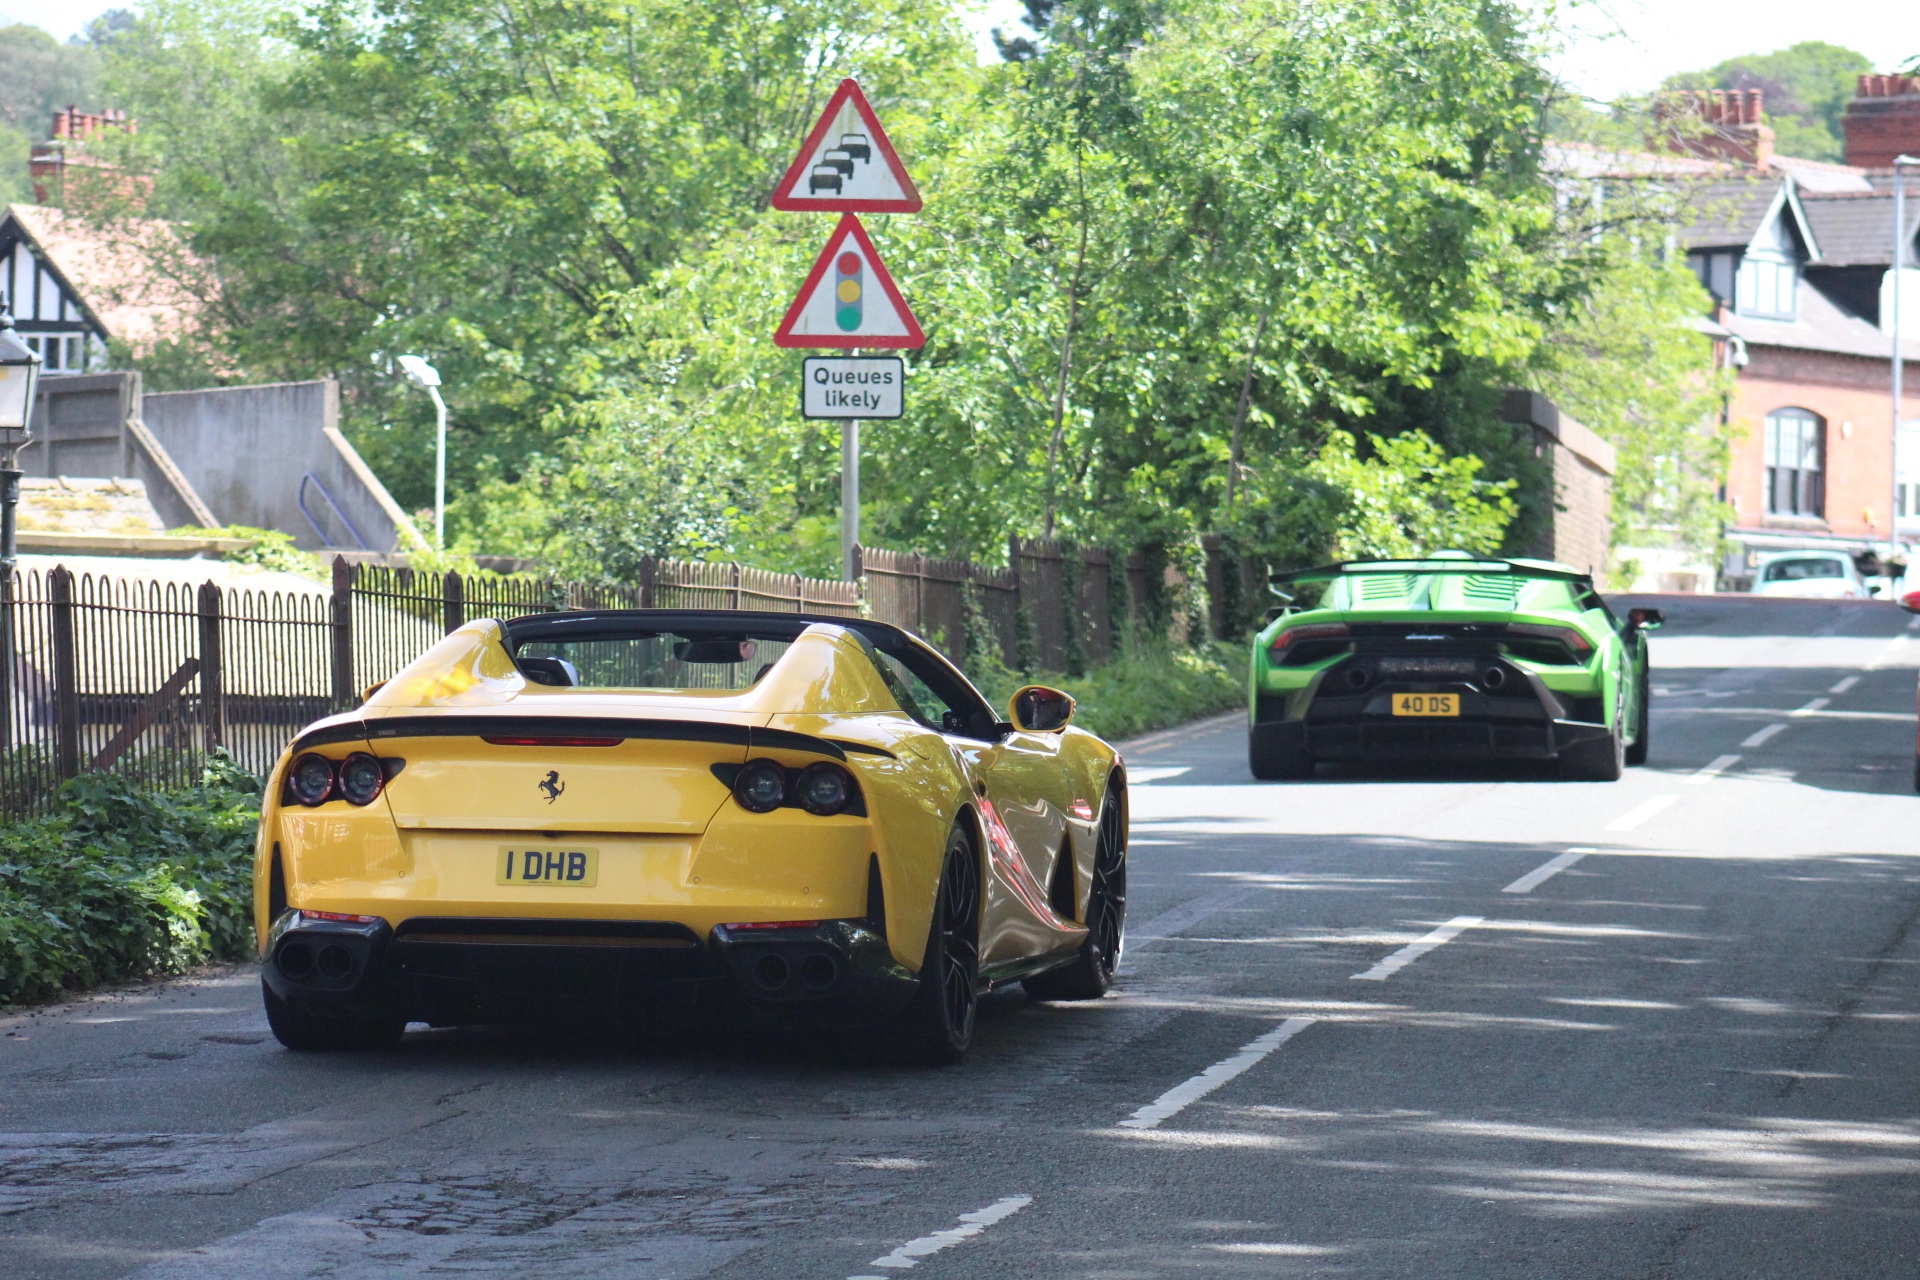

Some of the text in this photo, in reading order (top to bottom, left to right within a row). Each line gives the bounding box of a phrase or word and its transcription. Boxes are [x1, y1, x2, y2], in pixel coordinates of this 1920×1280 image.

[814, 367, 893, 385] Queues
[825, 390, 881, 410] likely
[1401, 697, 1451, 712] 40 DS
[522, 851, 587, 881] DHB
